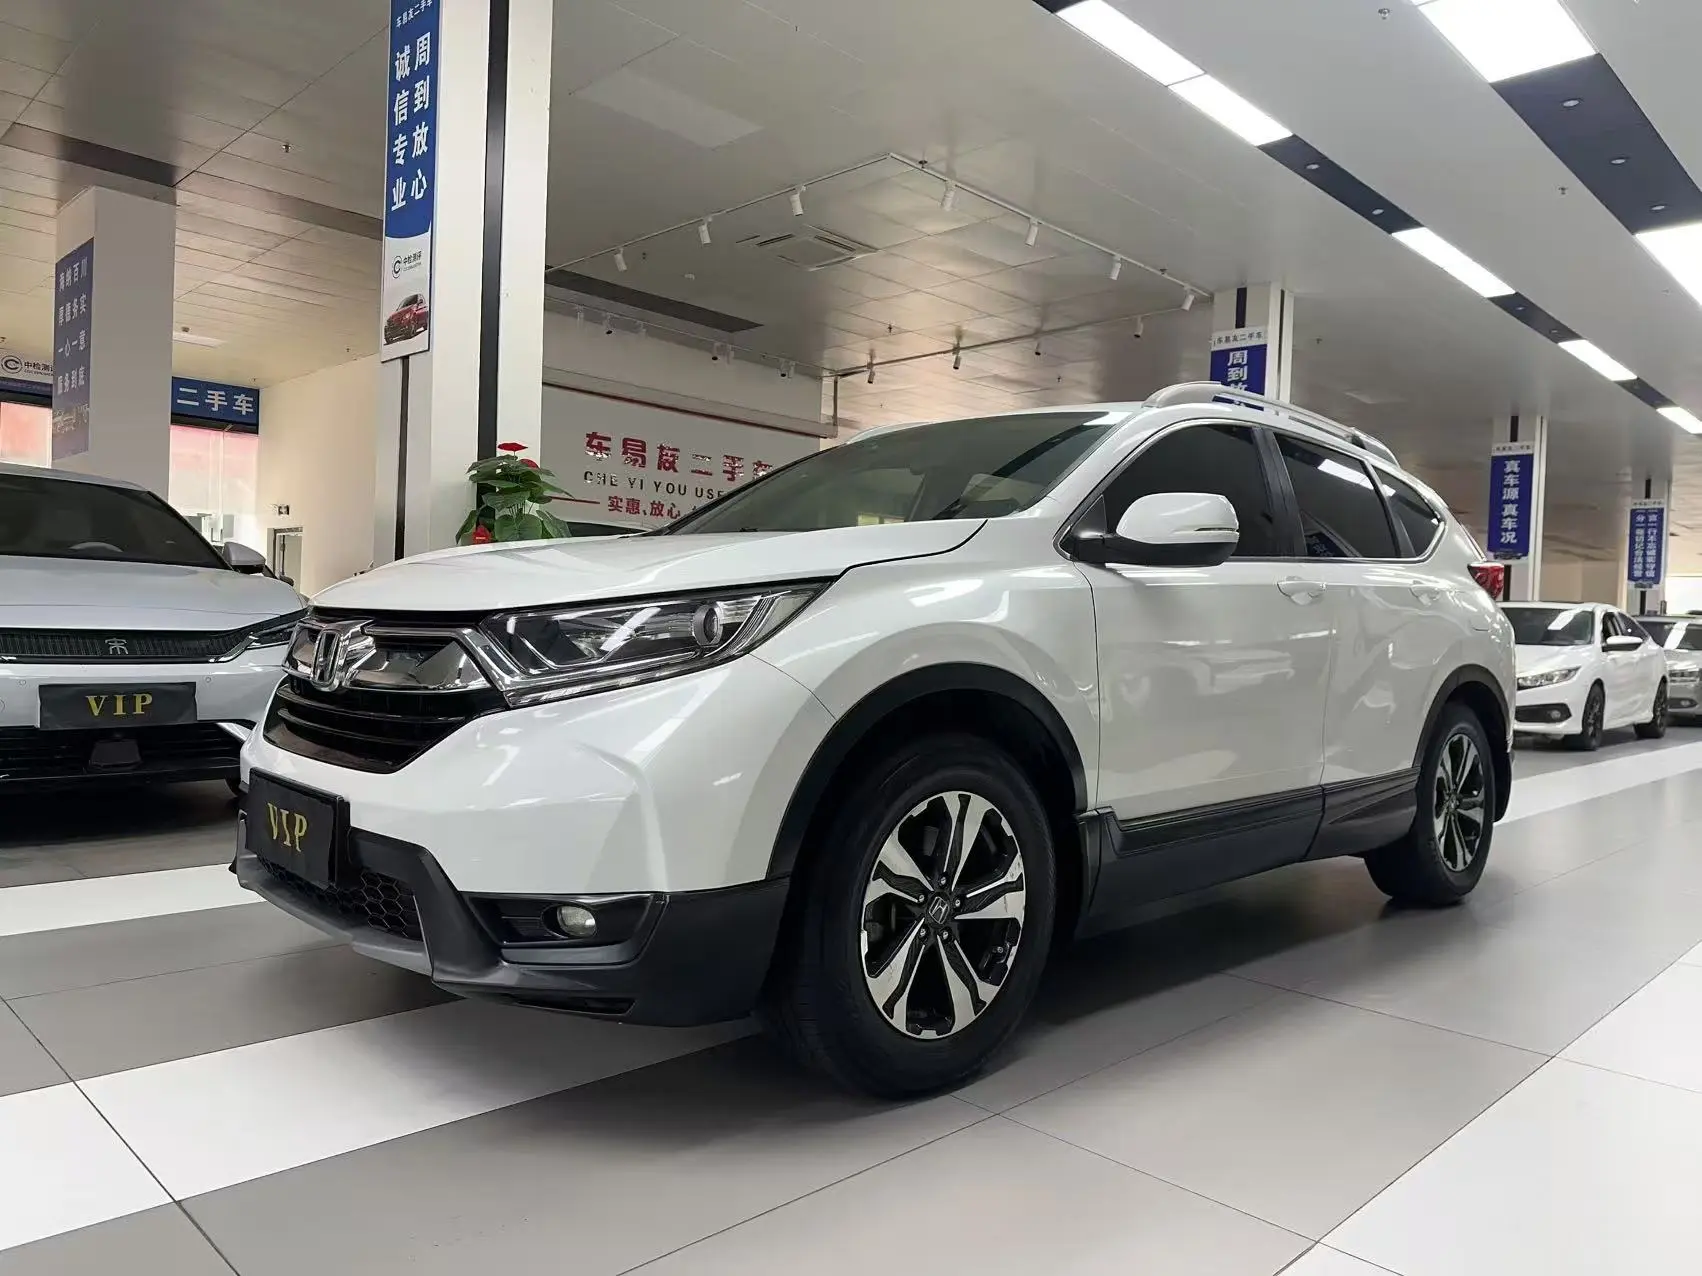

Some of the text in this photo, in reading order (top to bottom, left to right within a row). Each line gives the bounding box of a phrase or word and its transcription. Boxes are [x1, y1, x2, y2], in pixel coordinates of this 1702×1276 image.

[391, 44, 411, 211] 诚信专业
[410, 31, 431, 201] 周到放心
[58, 329, 86, 357] 一心一意
[176, 387, 254, 416] 二手车
[583, 470, 619, 487] CHE
[628, 478, 645, 490] YI
[653, 480, 687, 496] YOU
[1502, 459, 1521, 500] 真车源
[1500, 503, 1519, 544] 真车况
[85, 693, 153, 717] VIP
[267, 802, 308, 852] VIP
